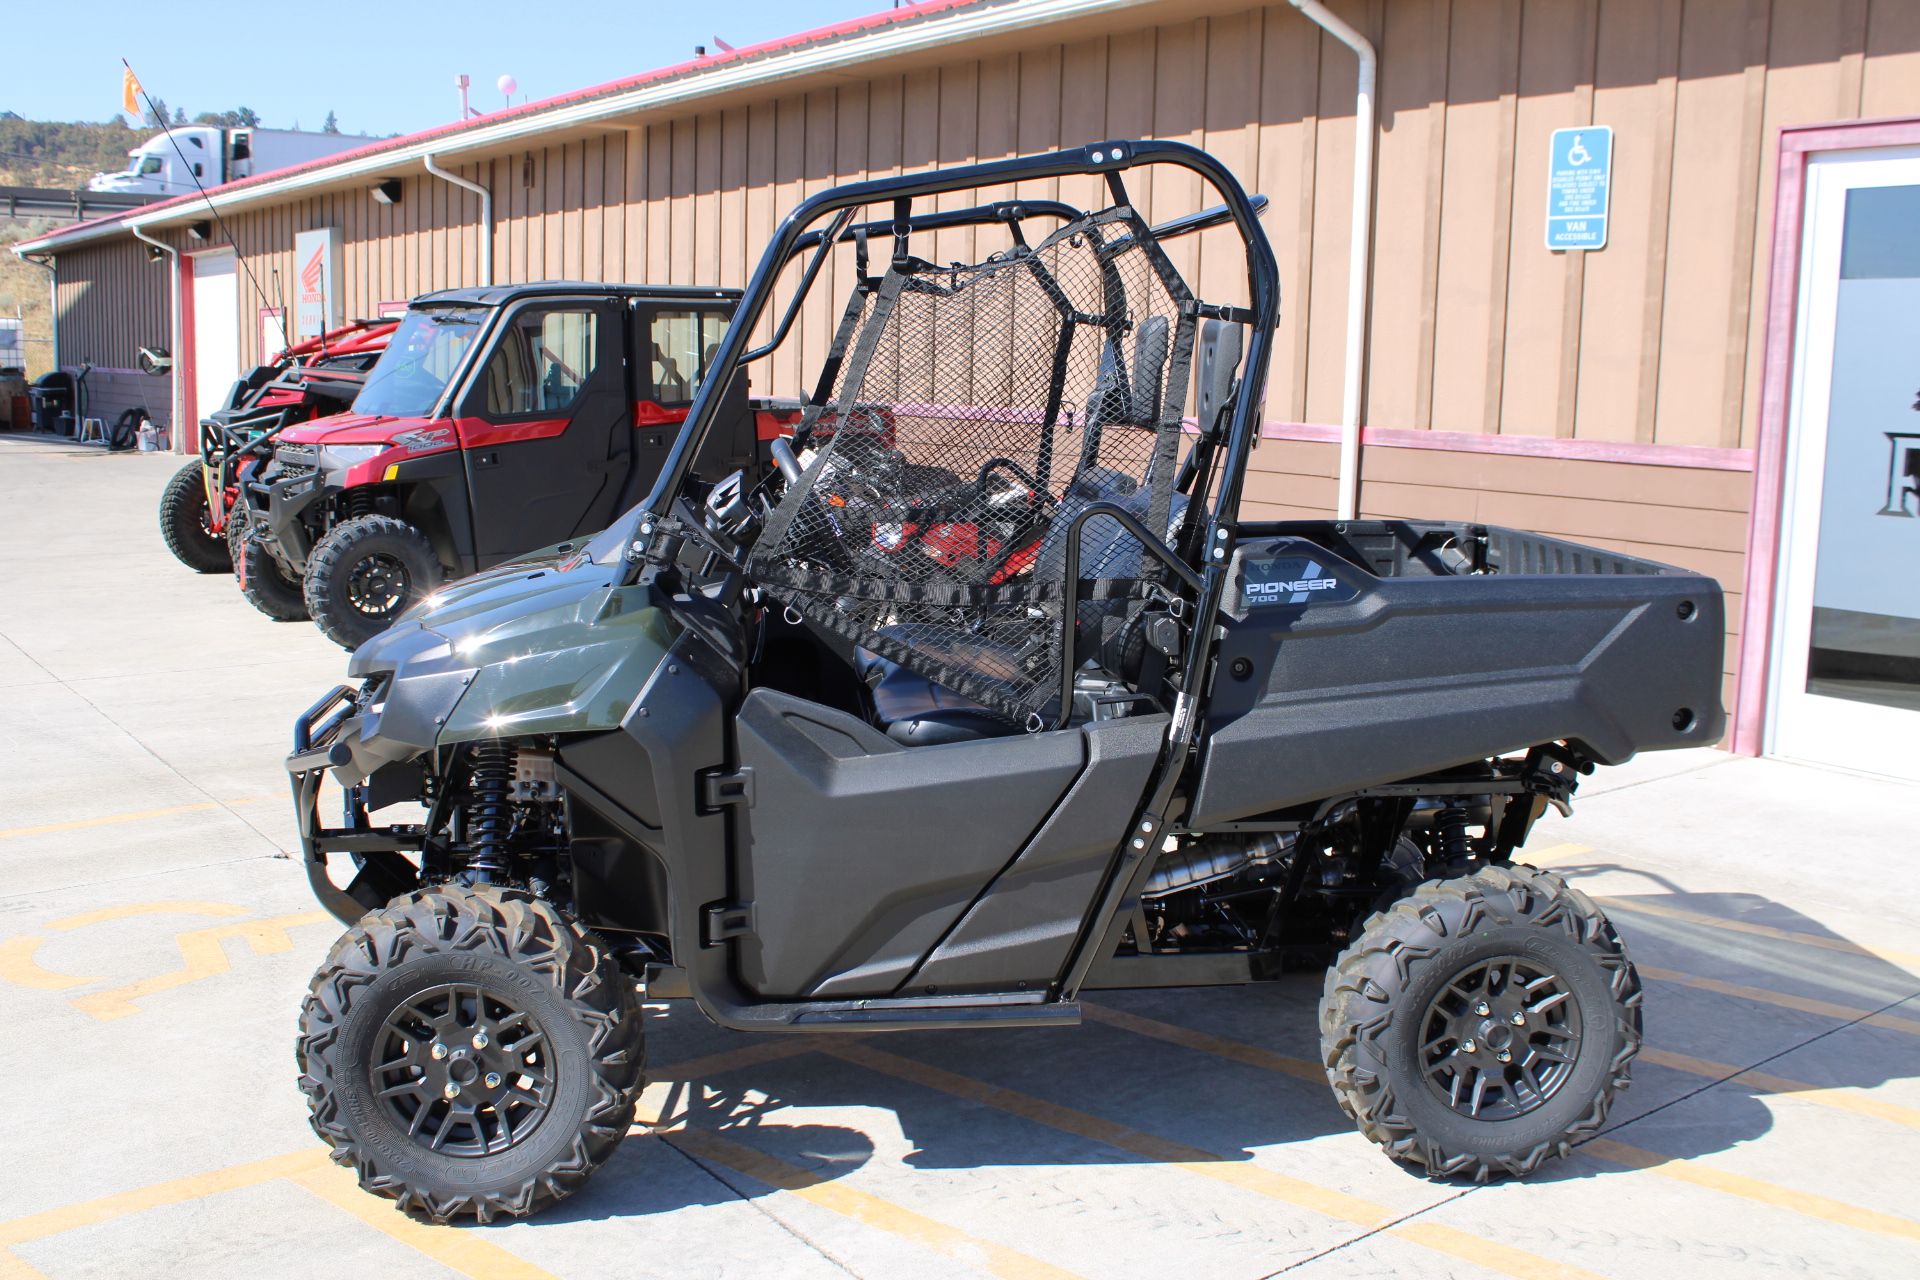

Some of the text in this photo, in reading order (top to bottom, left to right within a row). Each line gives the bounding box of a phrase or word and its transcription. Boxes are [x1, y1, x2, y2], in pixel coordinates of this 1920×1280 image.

[1566, 221, 1587, 232] VAN
[1555, 232, 1597, 241] ACCESSIBLE
[1246, 578, 1337, 595] PIONEER
[1248, 594, 1278, 603] 700
